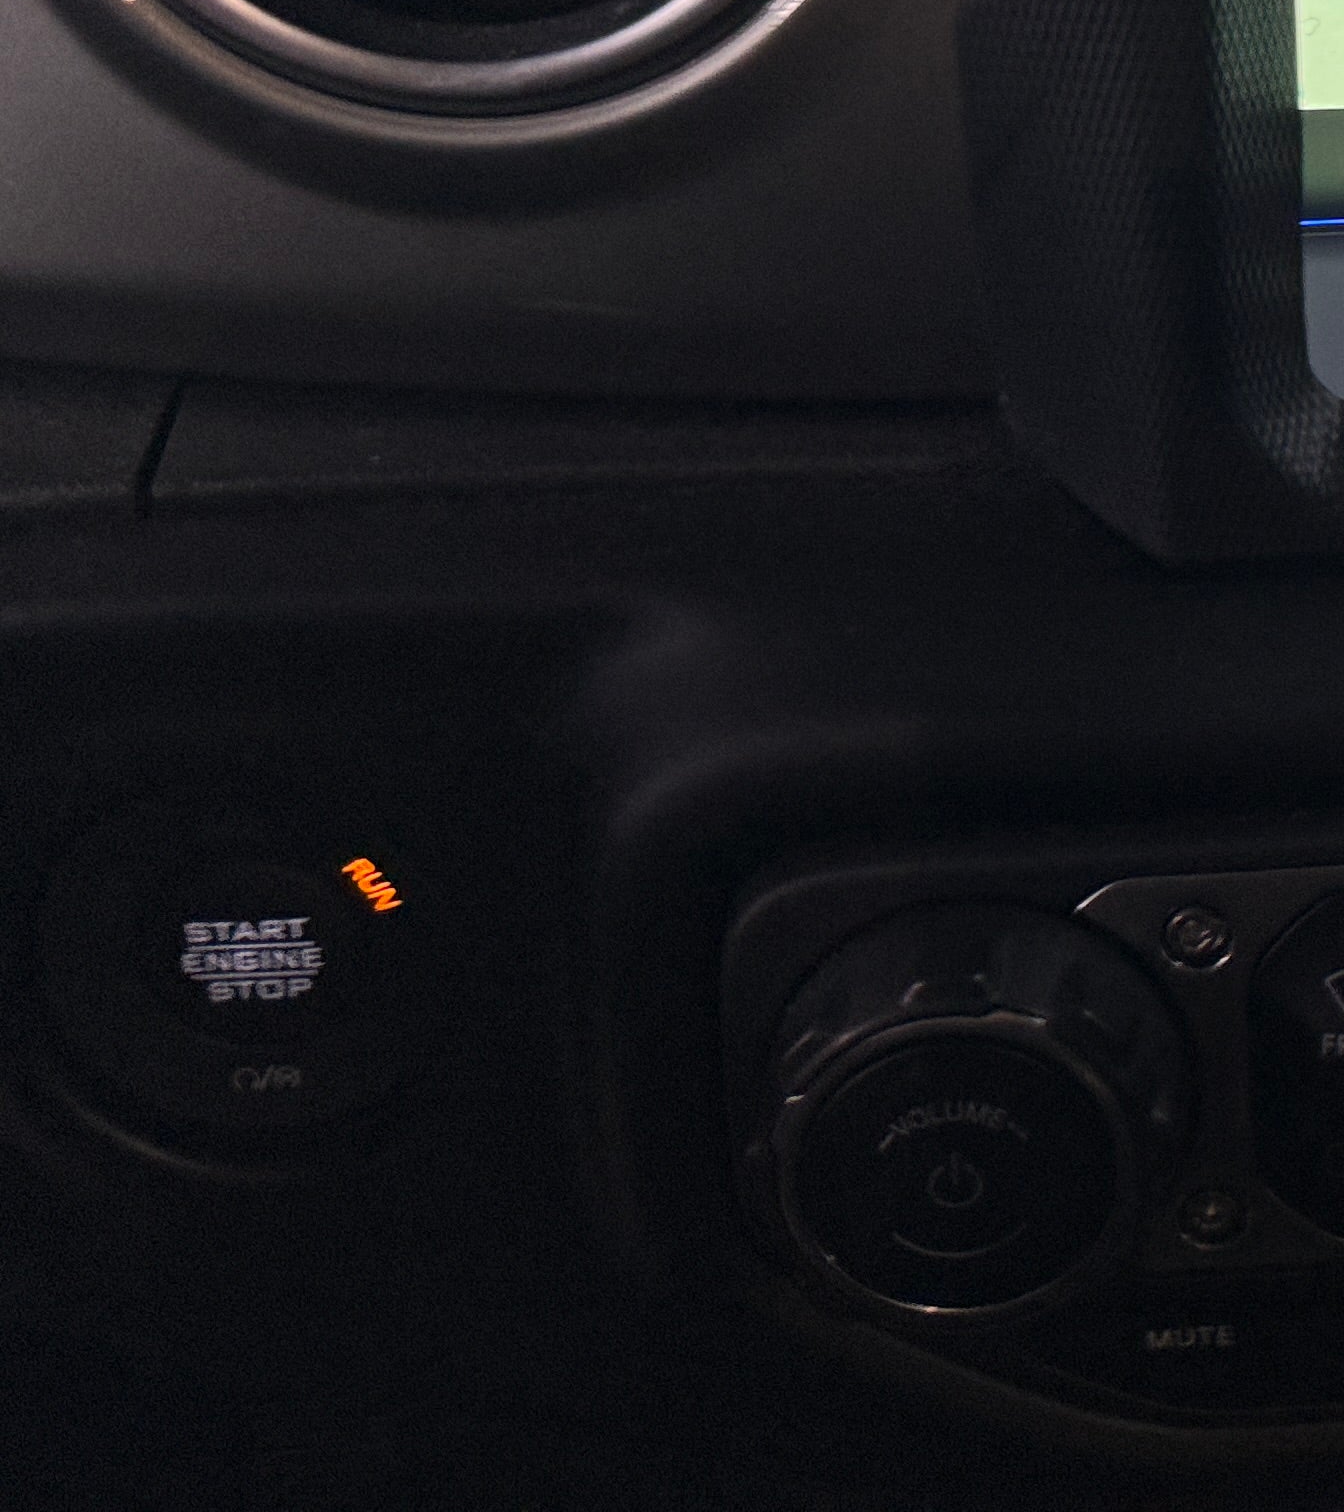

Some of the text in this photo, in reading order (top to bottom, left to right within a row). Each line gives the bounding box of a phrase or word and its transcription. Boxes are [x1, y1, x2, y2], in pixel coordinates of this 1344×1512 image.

[342, 858, 403, 912] RUN
[183, 917, 311, 943] START
[181, 947, 326, 973] ENGINE
[207, 978, 313, 1003] STOP
[888, 1100, 1008, 1136] VOLUME
[1146, 1324, 1238, 1352] MUTE
